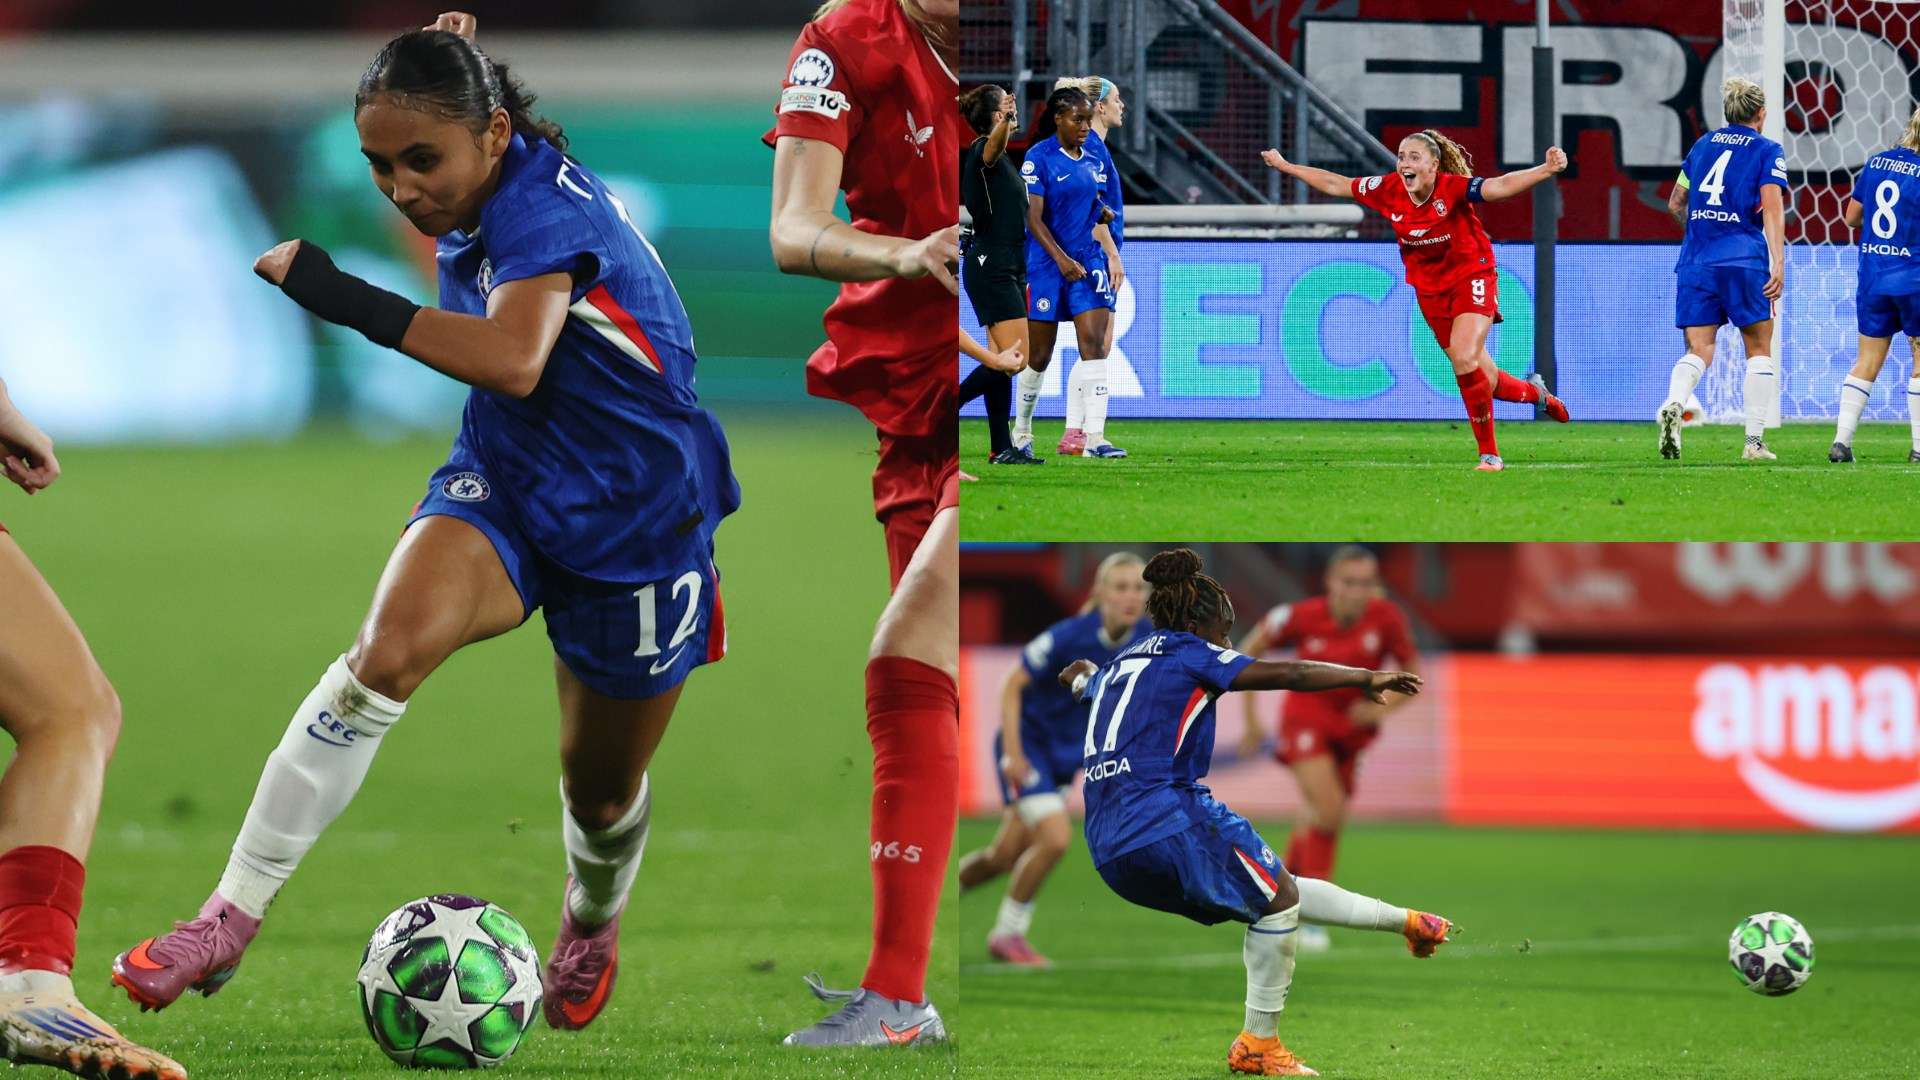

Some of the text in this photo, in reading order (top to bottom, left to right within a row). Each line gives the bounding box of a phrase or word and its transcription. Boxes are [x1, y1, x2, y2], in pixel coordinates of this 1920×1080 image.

[1305, 20, 1912, 172] FRO
[1711, 132, 1754, 147] BRIGHT
[1698, 149, 1733, 206] 4
[1871, 180, 1900, 240] 8
[1472, 279, 1485, 296] 8
[633, 570, 702, 656] 12
[318, 710, 358, 742] CFC
[1084, 657, 1152, 758] 17
[1084, 757, 1132, 783] KODA
